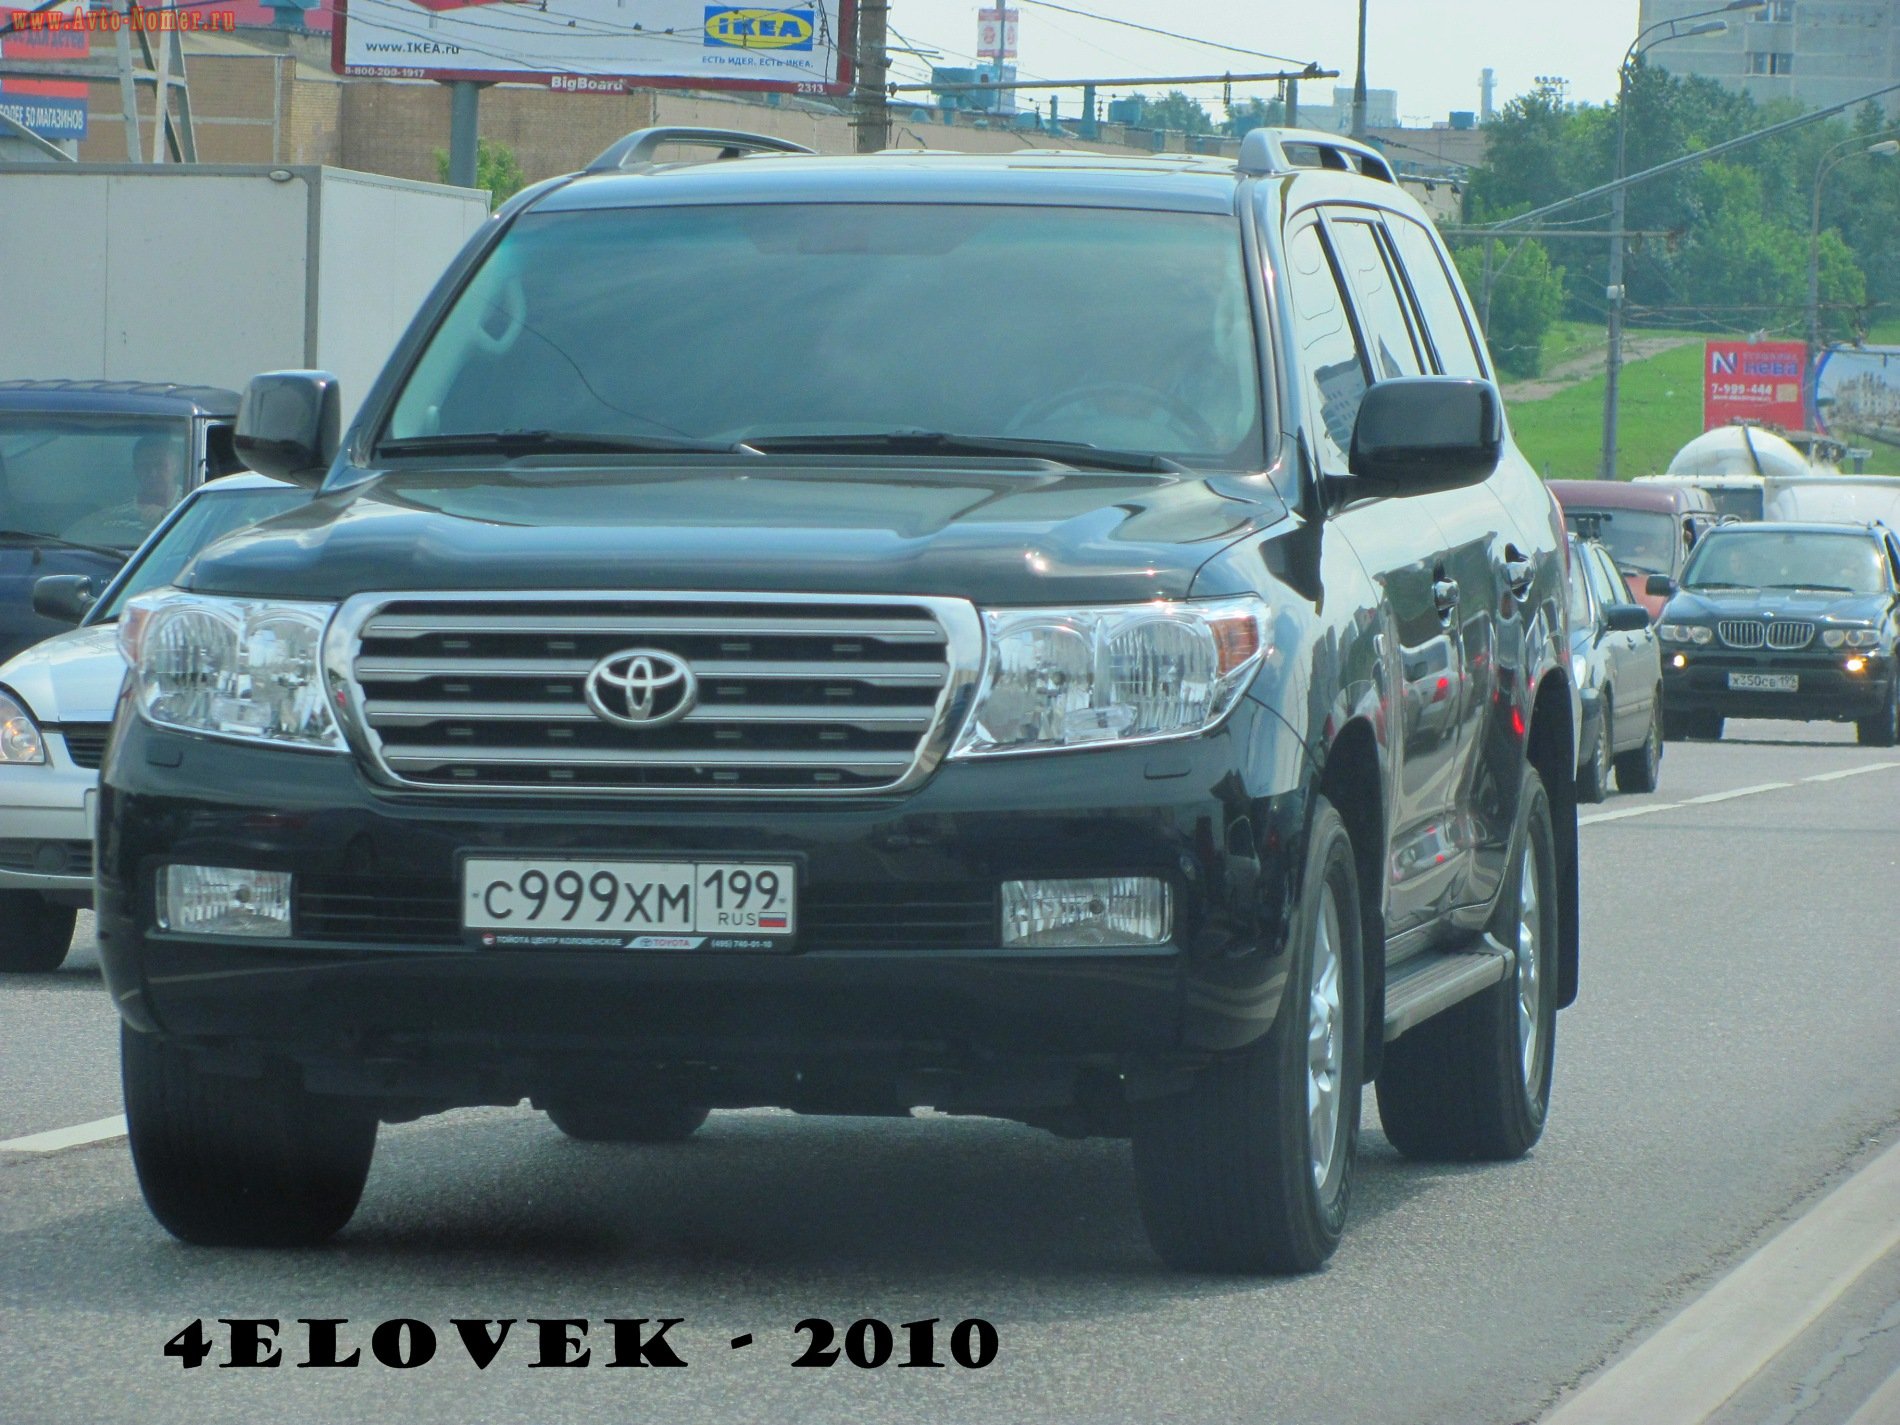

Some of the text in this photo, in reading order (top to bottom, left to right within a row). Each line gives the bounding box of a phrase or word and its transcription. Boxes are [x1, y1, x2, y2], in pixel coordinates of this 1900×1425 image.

[718, 17, 802, 38] IKEA
[365, 41, 461, 55] www.IKEA.ru
[702, 55, 726, 65] ЕСТЬ
[728, 56, 757, 66] ИДЕЯ.
[759, 58, 783, 67] ЕСТЬ
[551, 75, 624, 92] BigBoard
[798, 83, 824, 94] 2313
[25, 106, 36, 127] 50
[36, 107, 84, 131] МАГАЗИНОВ
[484, 869, 779, 924] С999ХМ 199
[718, 912, 756, 926] RUS
[653, 938, 691, 947] TOYOTA
